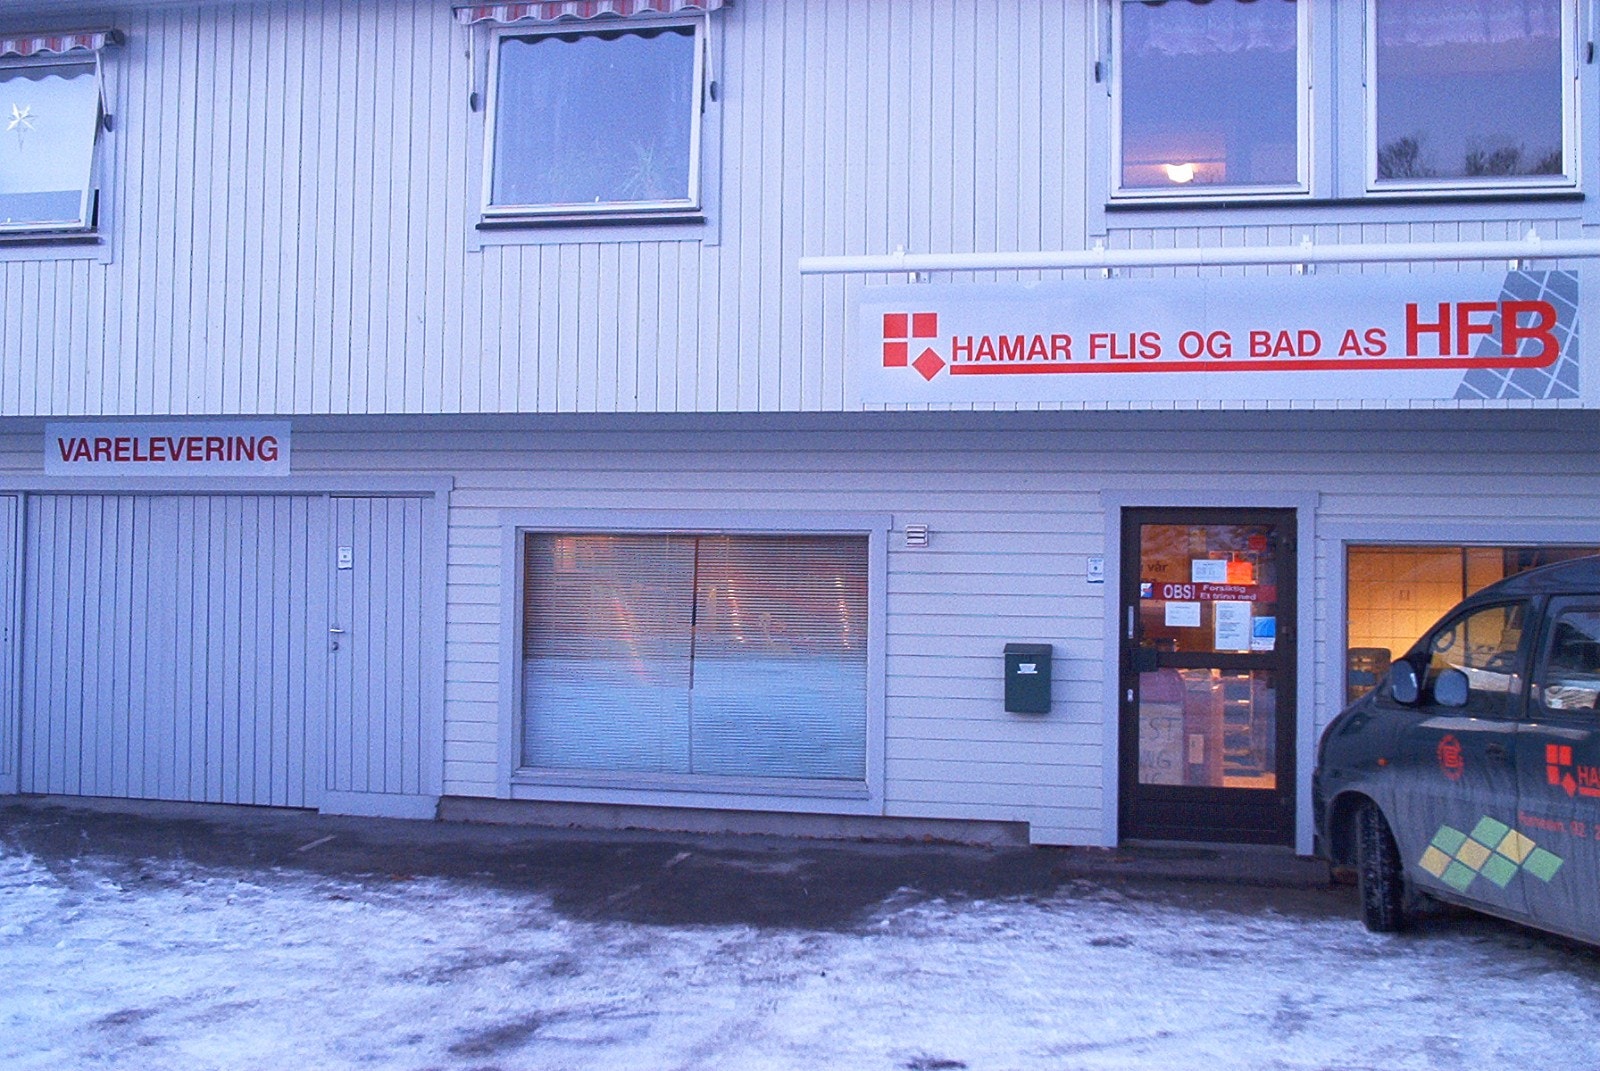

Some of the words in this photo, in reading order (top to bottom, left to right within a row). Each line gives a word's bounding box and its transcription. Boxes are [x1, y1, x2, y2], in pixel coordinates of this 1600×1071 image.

[952, 334, 1072, 362] HAMAR
[1089, 332, 1162, 360] FLIS
[1178, 330, 1232, 359] OG
[1249, 330, 1322, 358] BAD
[1338, 328, 1387, 357] AS
[1406, 300, 1560, 362] HFB
[57, 435, 279, 462] VARELEVERING
[1163, 584, 1196, 599] OBS!
